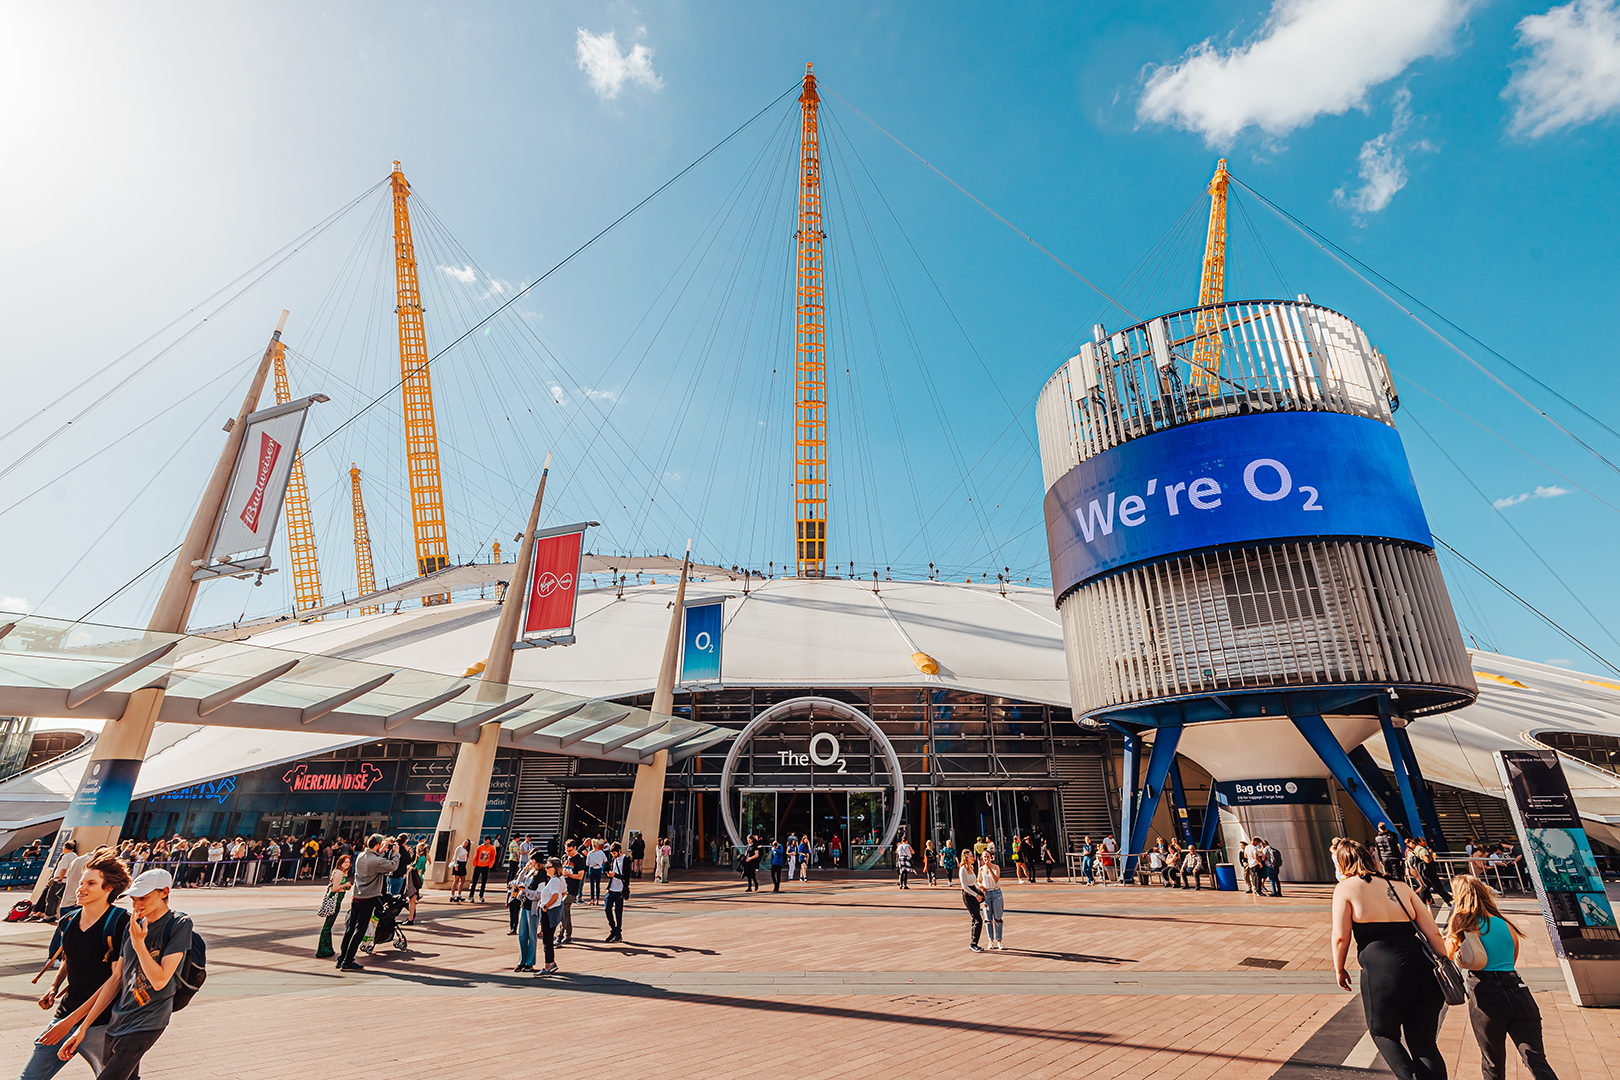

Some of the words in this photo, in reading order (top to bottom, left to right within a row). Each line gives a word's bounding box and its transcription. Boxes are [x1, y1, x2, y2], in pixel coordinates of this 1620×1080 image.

[245, 439, 274, 524] Budweiser
[1075, 477, 1222, 544] We're
[1243, 458, 1323, 511] O2
[695, 631, 714, 653] O2
[777, 750, 809, 766] The
[809, 732, 847, 774] O2
[294, 773, 369, 791] MERCHANDISE
[489, 780, 511, 789] ickets
[1235, 783, 1254, 795] Bag
[1256, 782, 1282, 794] drop
